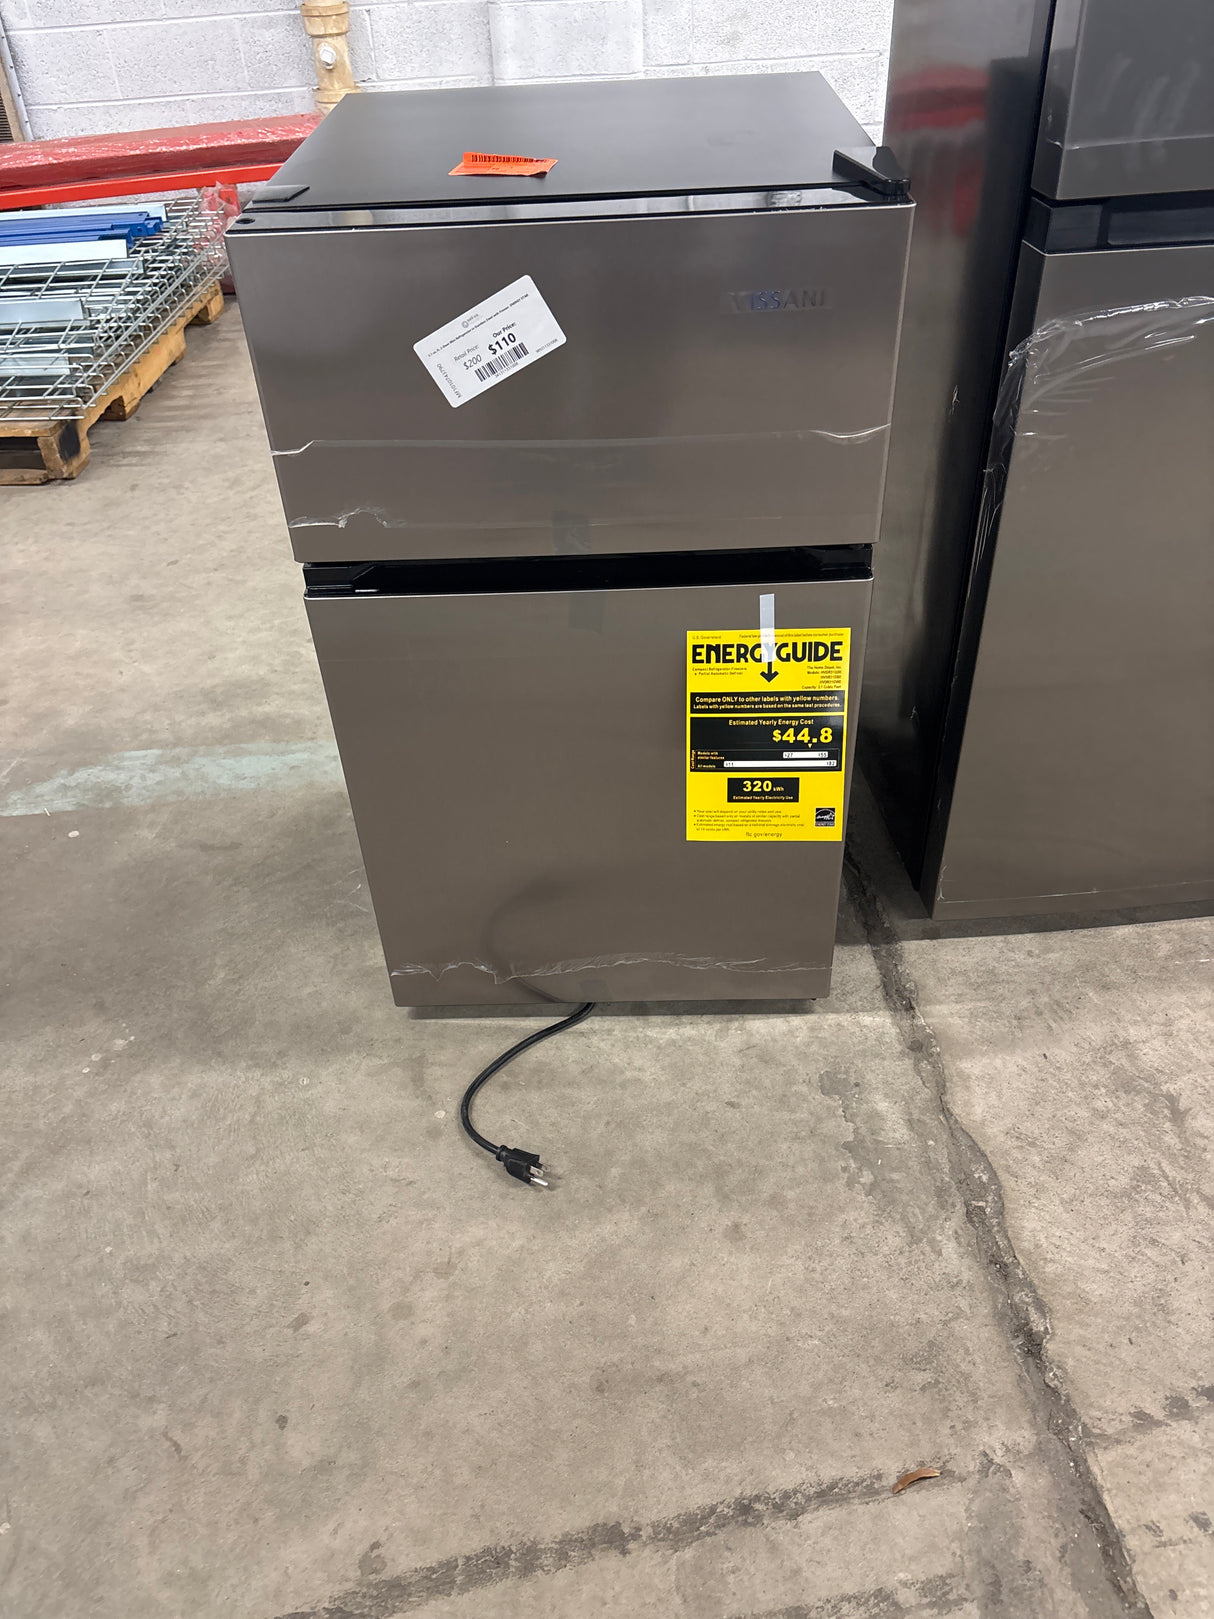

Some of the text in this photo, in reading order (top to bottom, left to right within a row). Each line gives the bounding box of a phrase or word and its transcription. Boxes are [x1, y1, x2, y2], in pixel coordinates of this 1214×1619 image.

[727, 288, 825, 312] VISSANI
[492, 321, 517, 338] Our Price:
[488, 332, 516, 355] $110
[454, 344, 480, 361] Retail Price:
[463, 354, 482, 370] $200
[692, 641, 843, 664] ENERGYGUIDE
[792, 695, 812, 703] yellow
[759, 719, 777, 727] Yearly
[772, 727, 833, 743] $44.8
[742, 780, 772, 792] 320
